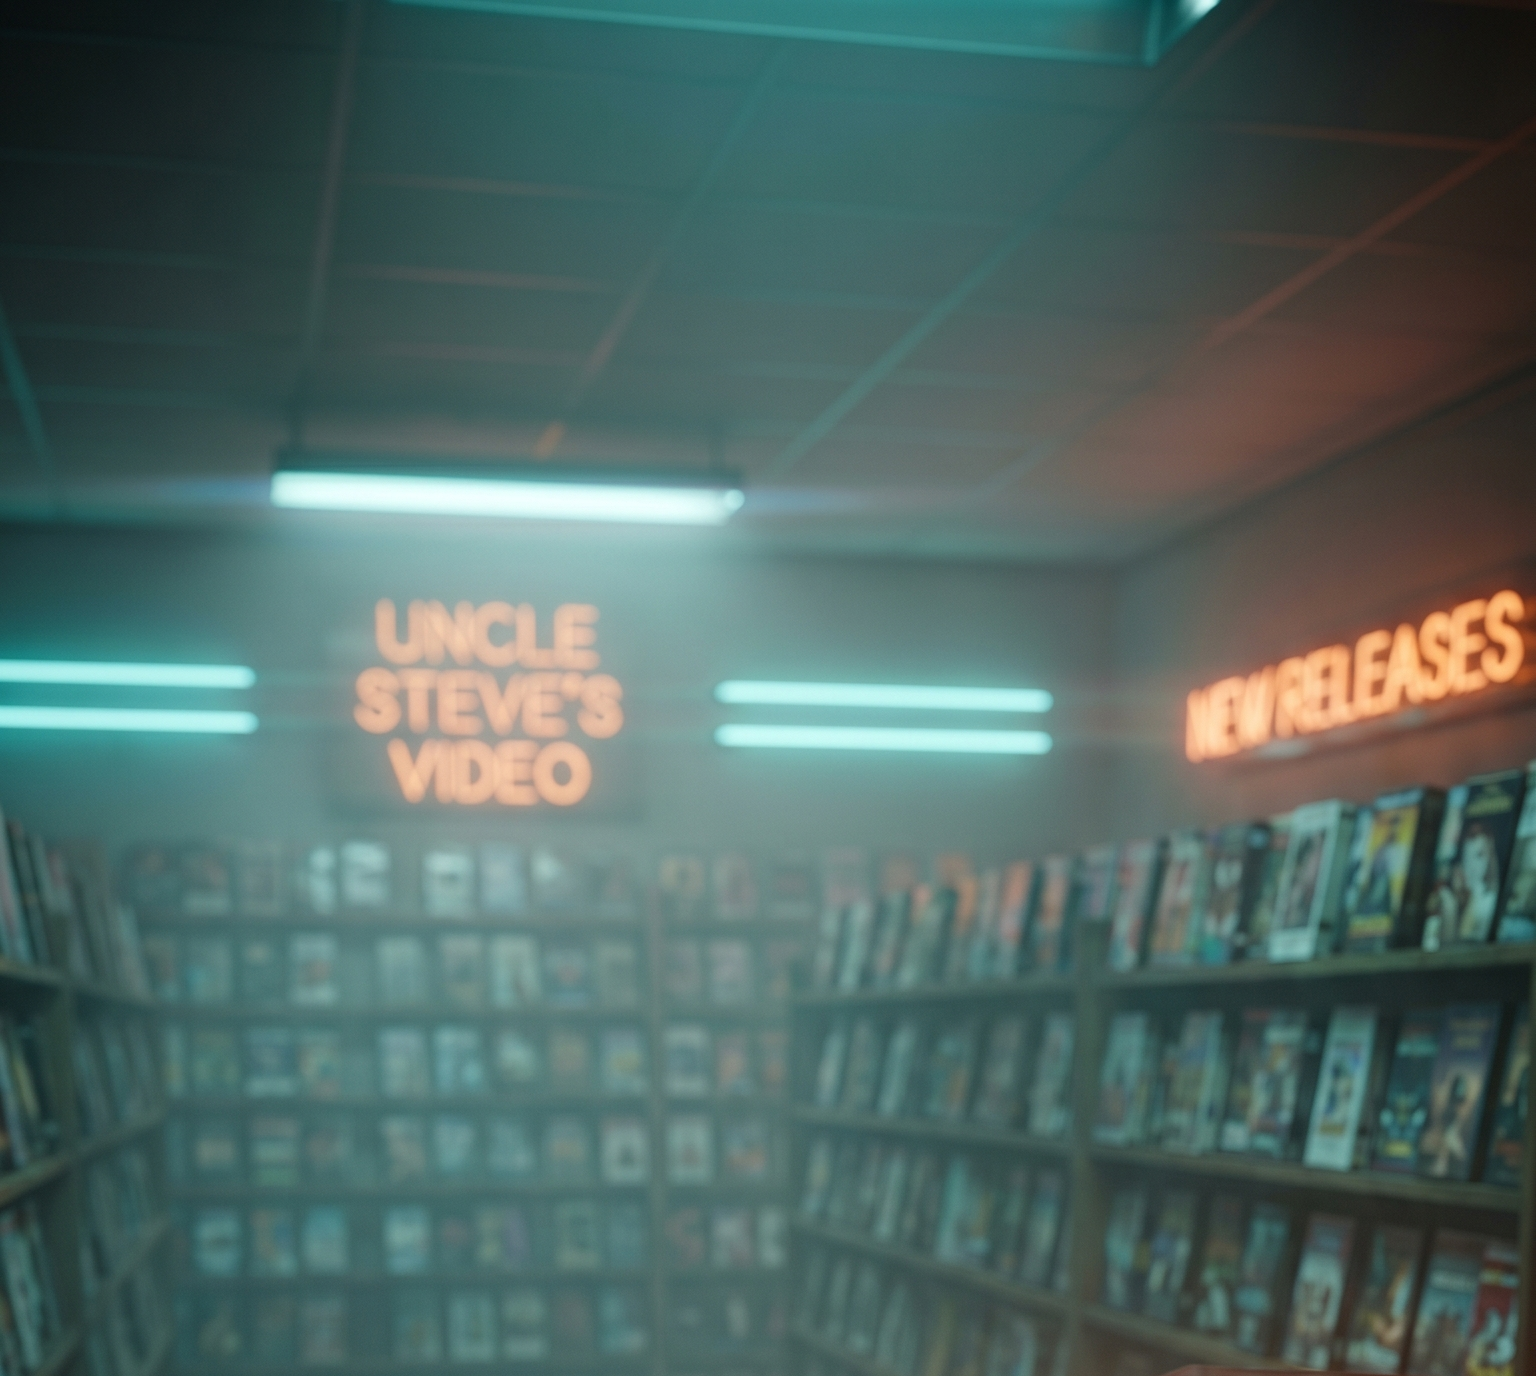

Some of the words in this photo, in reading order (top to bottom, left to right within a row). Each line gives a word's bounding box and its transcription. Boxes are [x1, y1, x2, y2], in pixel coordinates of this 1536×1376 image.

[374, 598, 600, 670] UNCLE
[353, 667, 624, 739] STEVE'S
[1186, 665, 1276, 763] NEW
[1274, 590, 1525, 739] RELEASES
[387, 738, 592, 806] VIDEO
